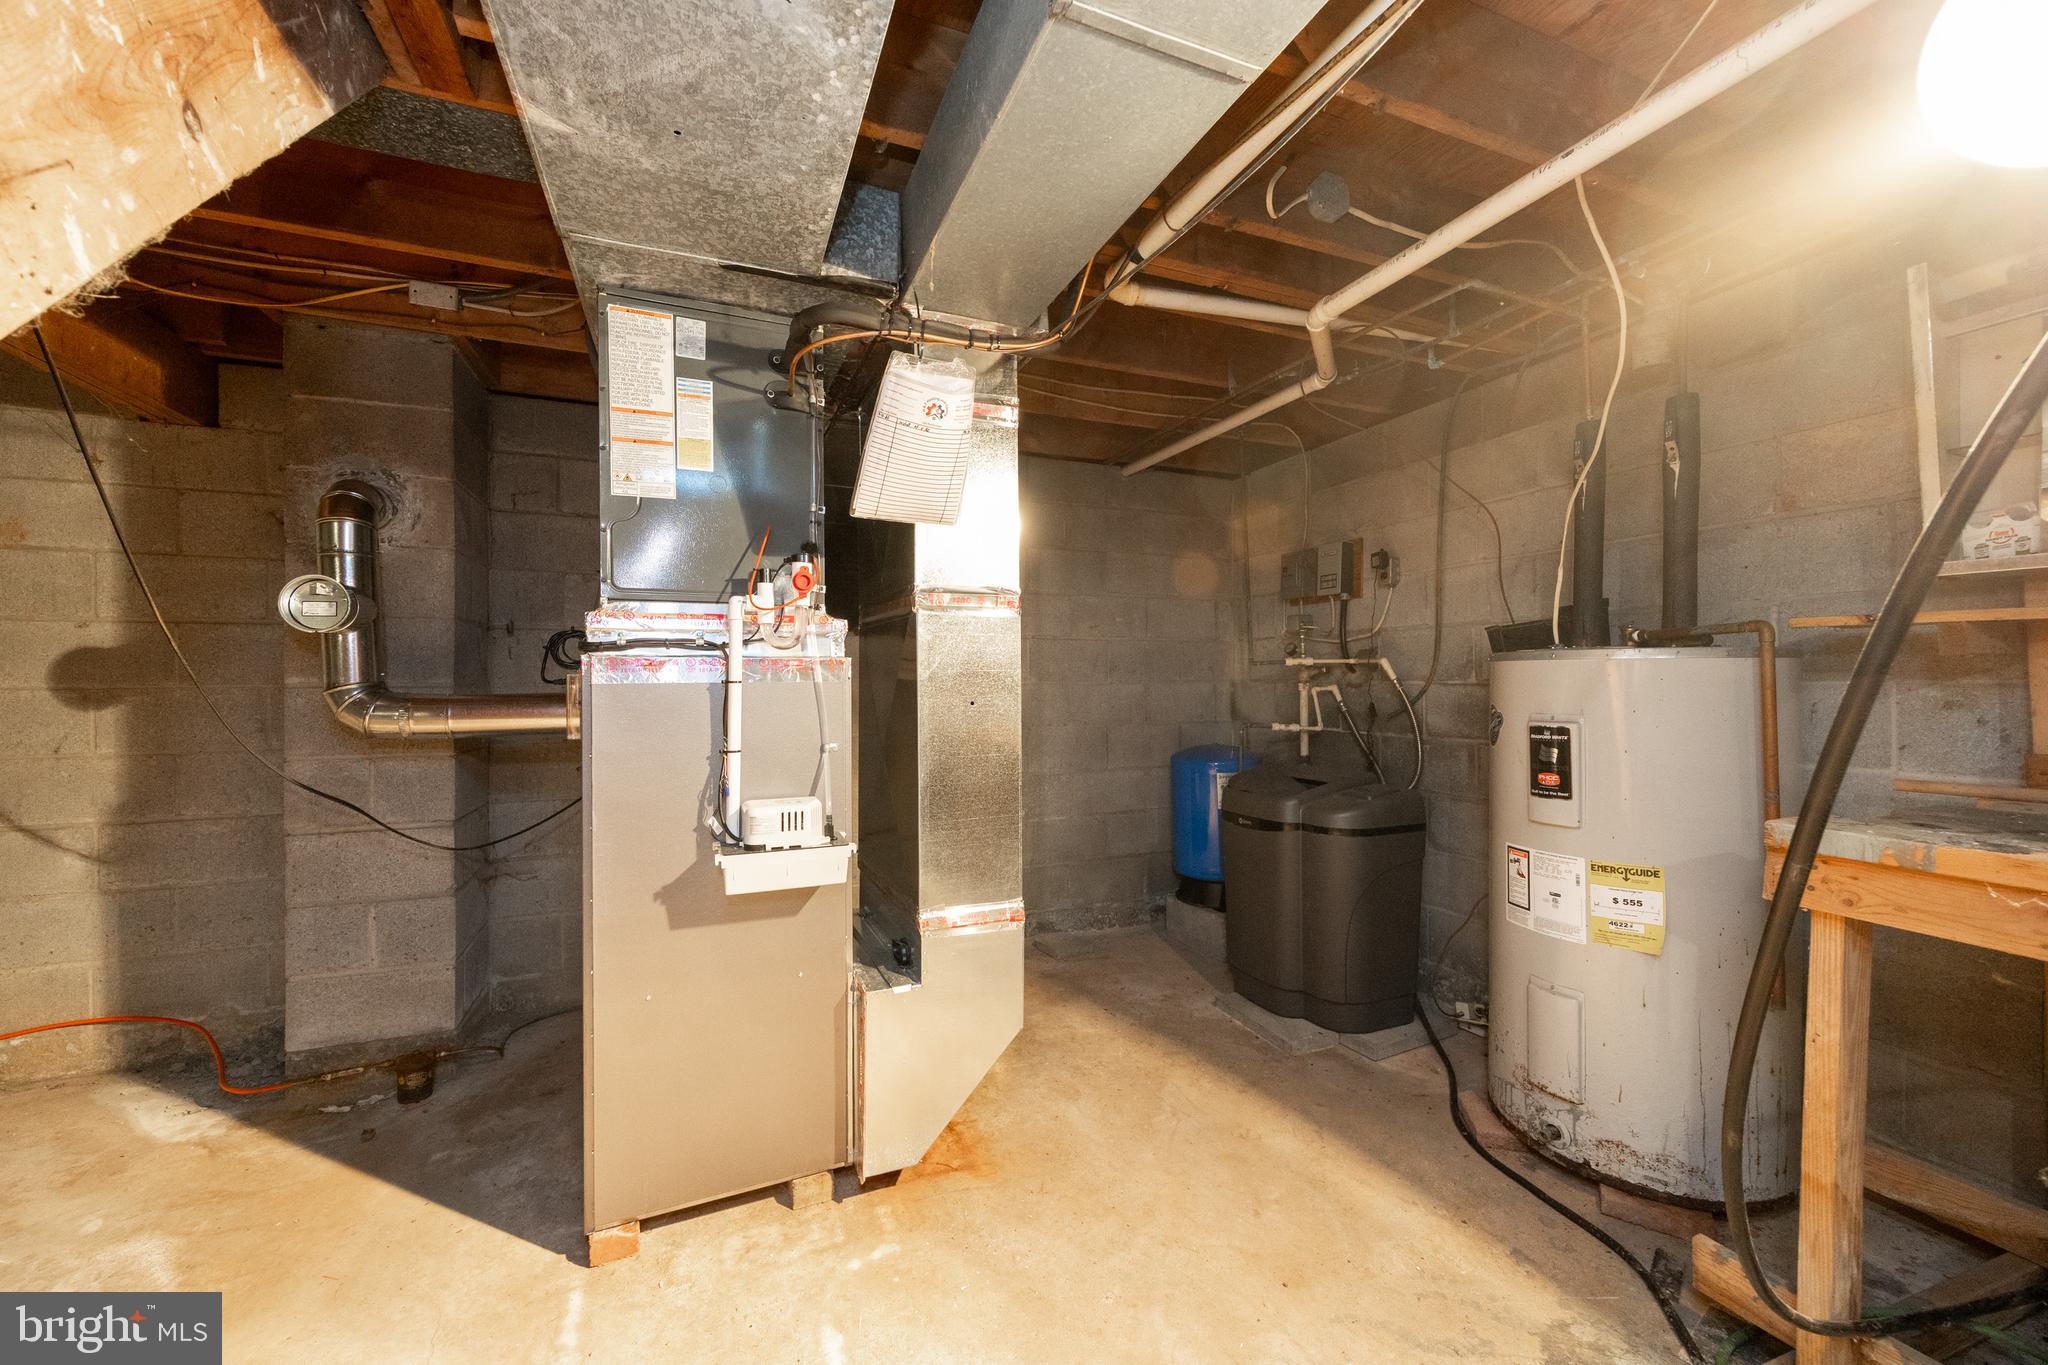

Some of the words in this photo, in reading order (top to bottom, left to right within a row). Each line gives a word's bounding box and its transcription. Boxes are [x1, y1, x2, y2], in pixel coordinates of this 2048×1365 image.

[1590, 863, 1661, 880] ENERGYGUIDE
[1612, 897, 1619, 905] $
[1622, 899, 1643, 907] 555
